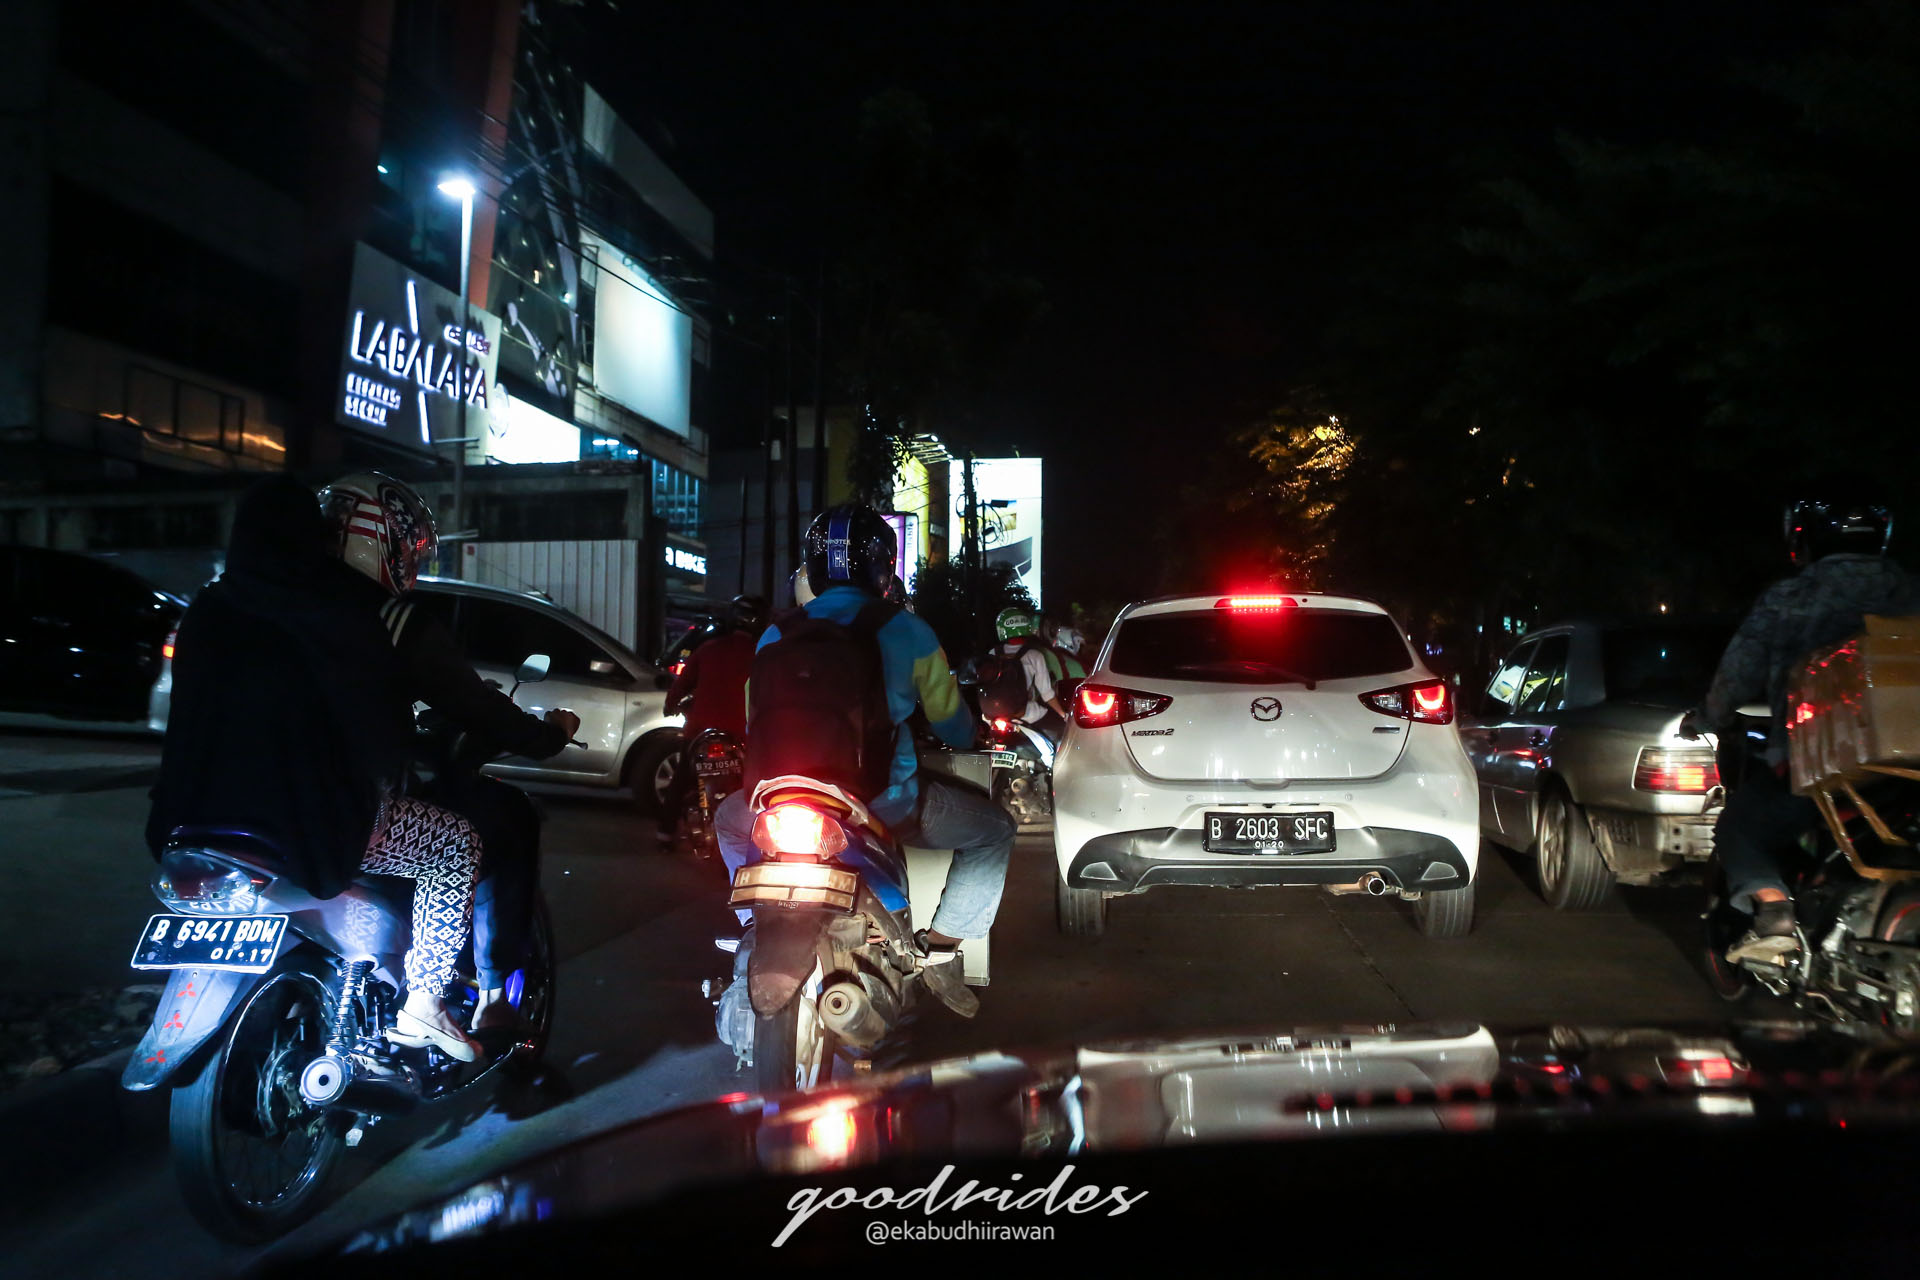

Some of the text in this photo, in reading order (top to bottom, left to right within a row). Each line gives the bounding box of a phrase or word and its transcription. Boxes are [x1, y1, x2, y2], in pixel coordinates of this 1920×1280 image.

[351, 310, 488, 410] LABALABA
[1211, 818, 1328, 840] B 2603 SFC
[153, 919, 281, 943] B 6941 BDW
